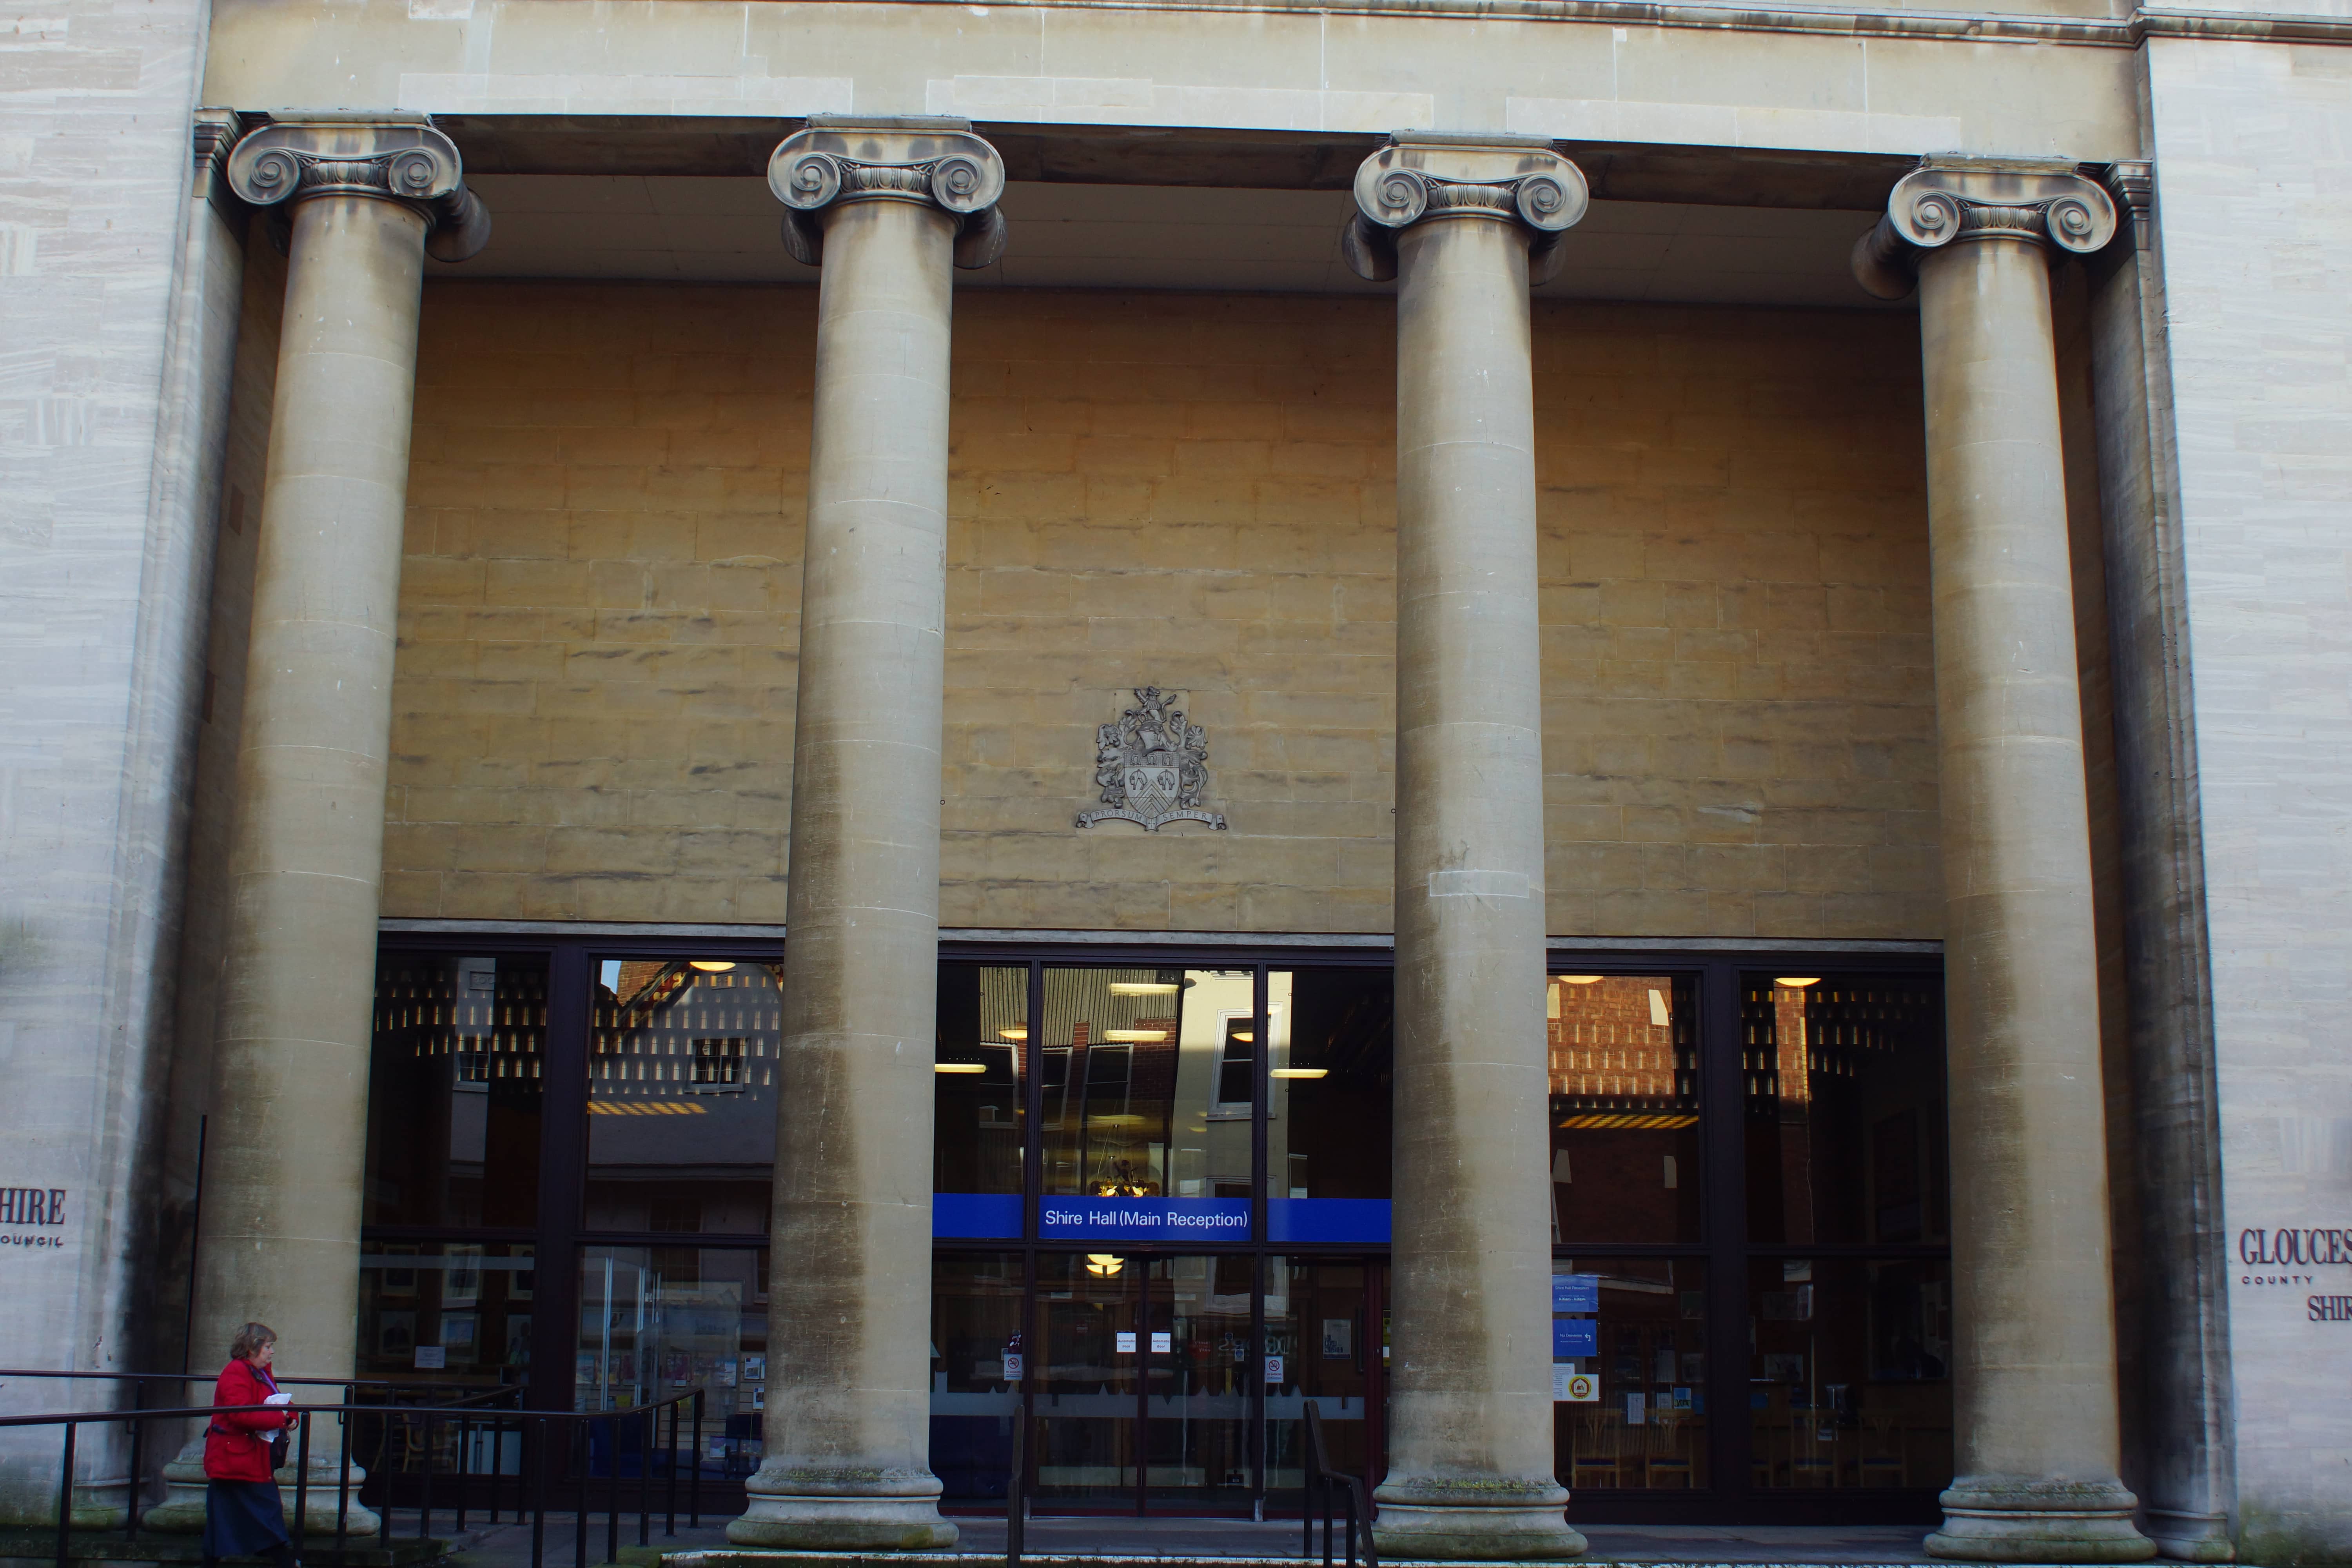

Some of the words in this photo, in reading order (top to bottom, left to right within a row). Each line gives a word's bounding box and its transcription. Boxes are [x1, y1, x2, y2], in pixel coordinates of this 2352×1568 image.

[1095, 809, 1142, 822] PRORSUM
[1163, 811, 1207, 821] SEMPER
[1045, 1210, 1083, 1225] Shire
[1090, 1210, 1116, 1225] Hall
[1120, 1210, 1161, 1228] (Main
[1168, 1210, 1248, 1229] Reception)
[2242, 1276, 2313, 1285] COUNTY
